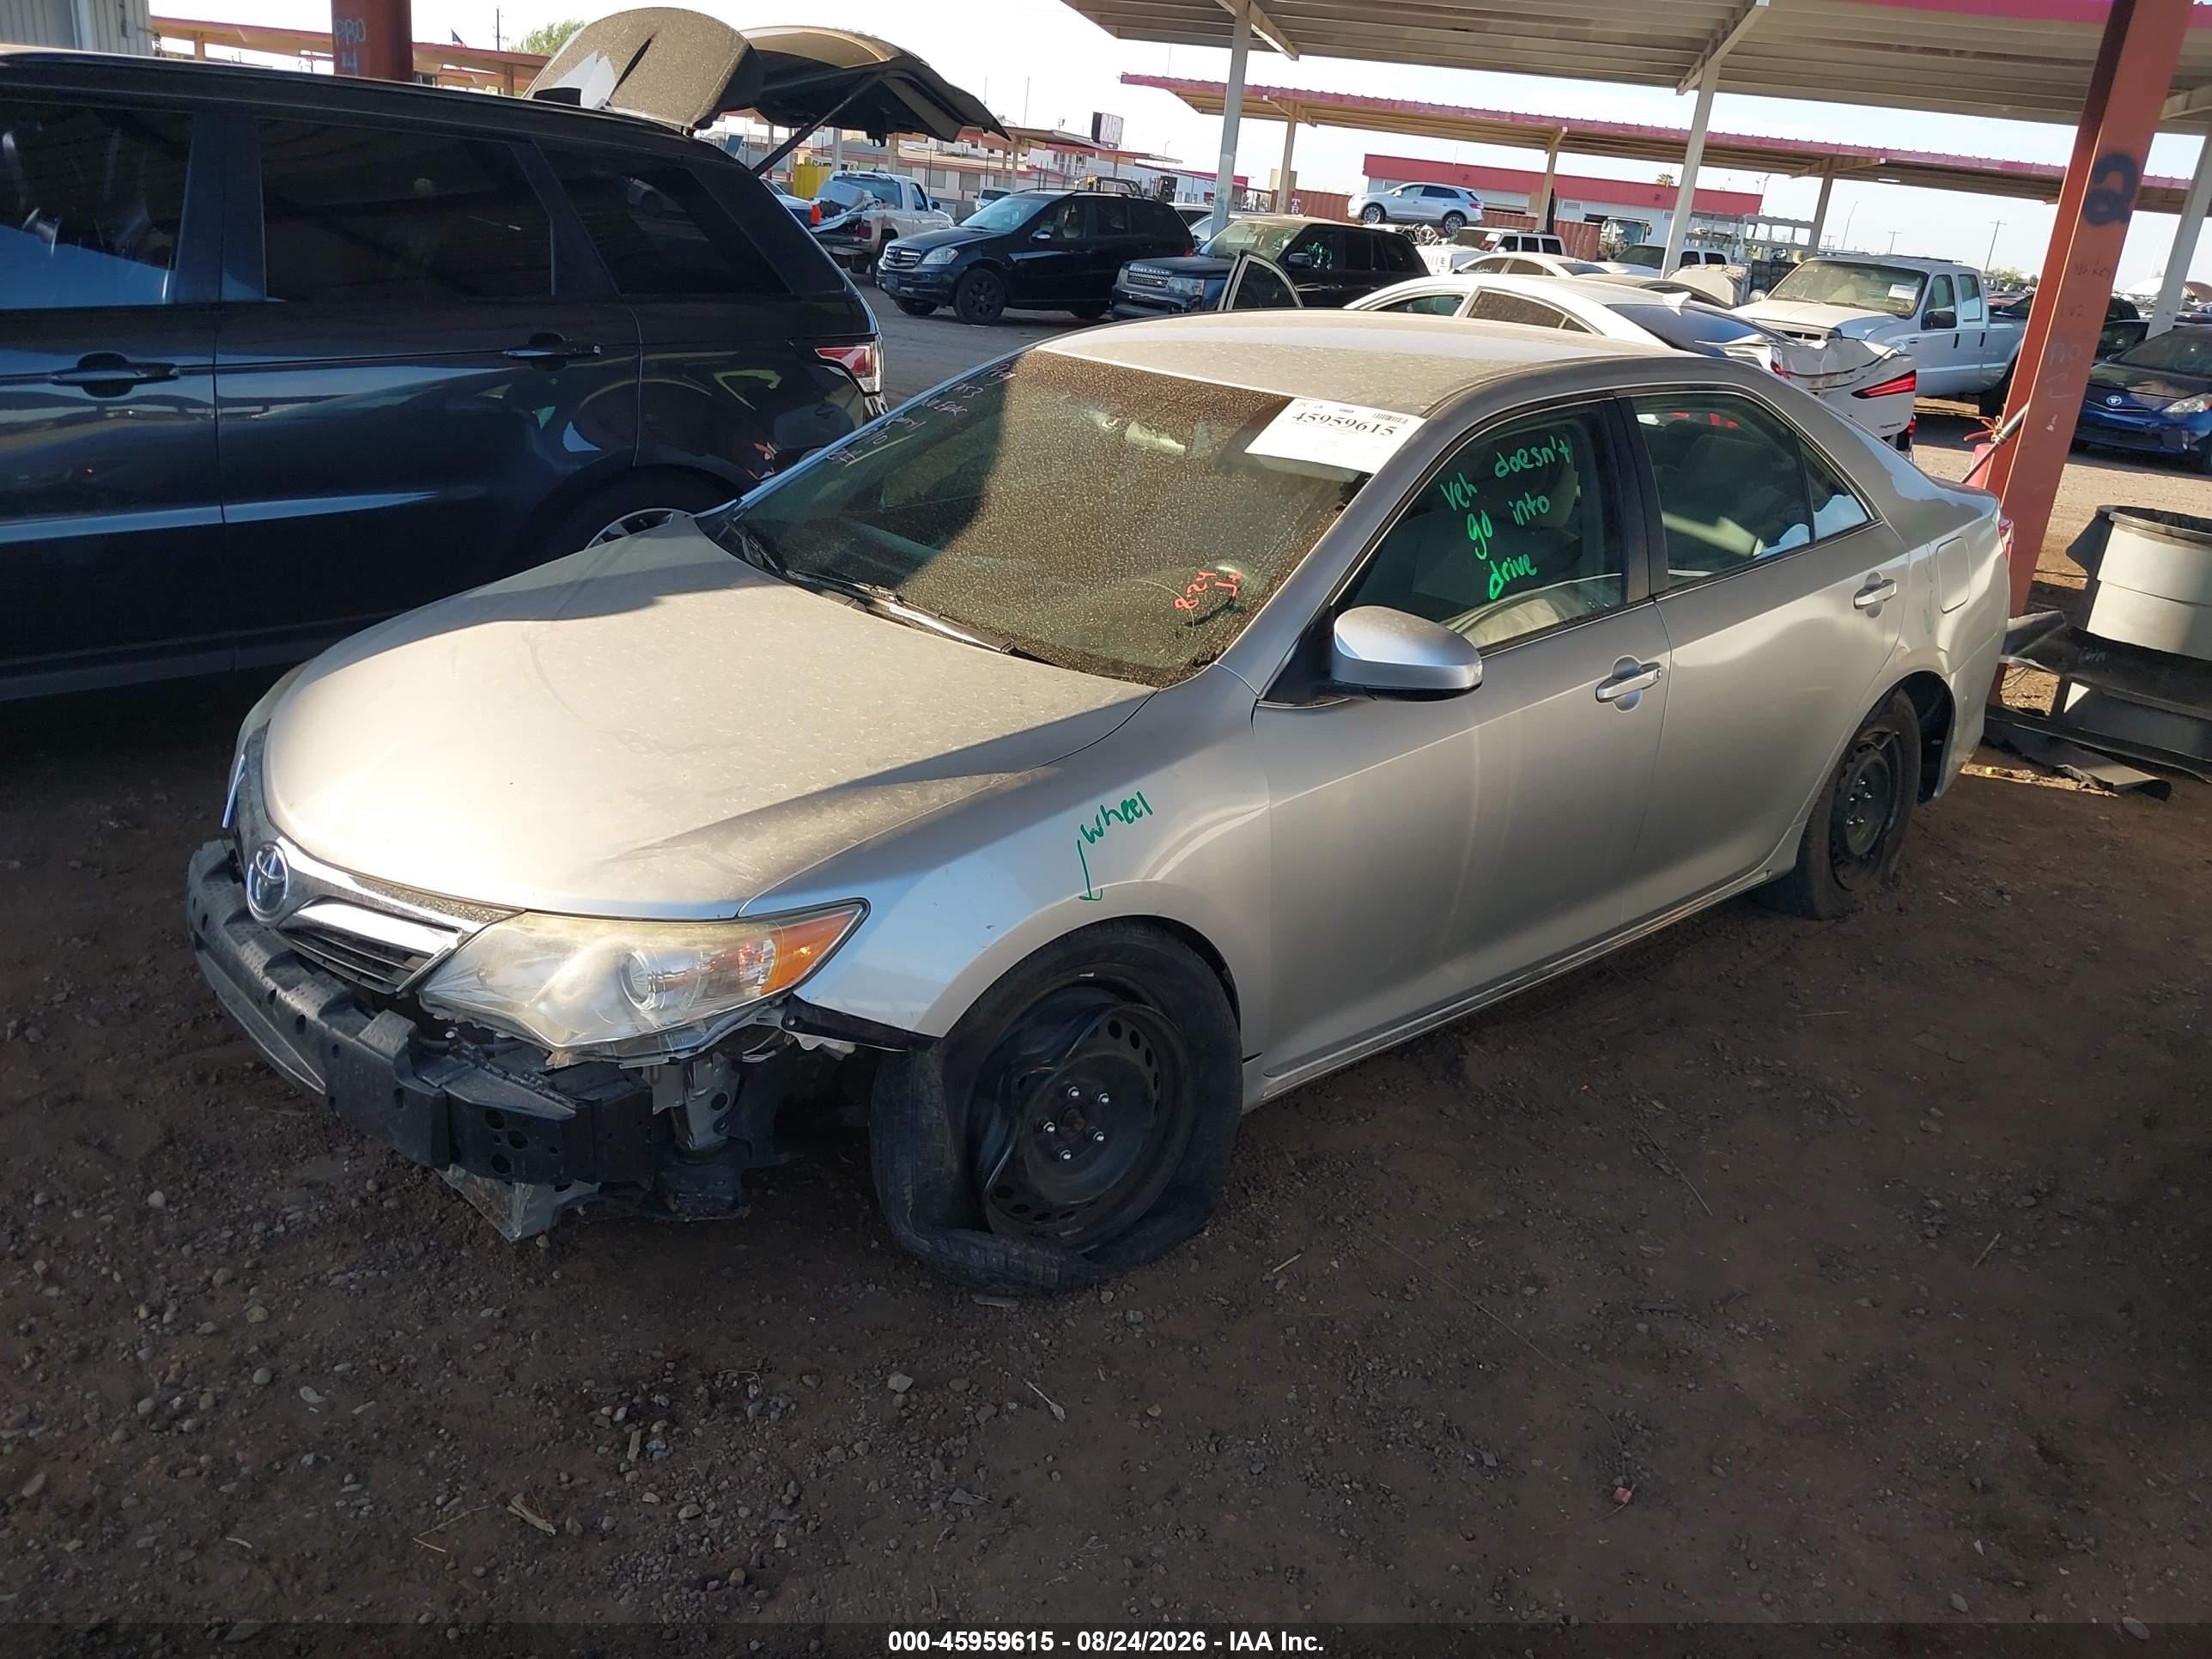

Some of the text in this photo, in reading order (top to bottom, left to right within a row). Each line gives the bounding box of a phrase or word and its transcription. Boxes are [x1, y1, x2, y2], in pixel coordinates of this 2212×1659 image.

[1292, 411, 1399, 436] 45959615
[1494, 435, 1571, 478] doesn't
[1467, 492, 1551, 561] go into
[1488, 554, 1537, 600] drive
